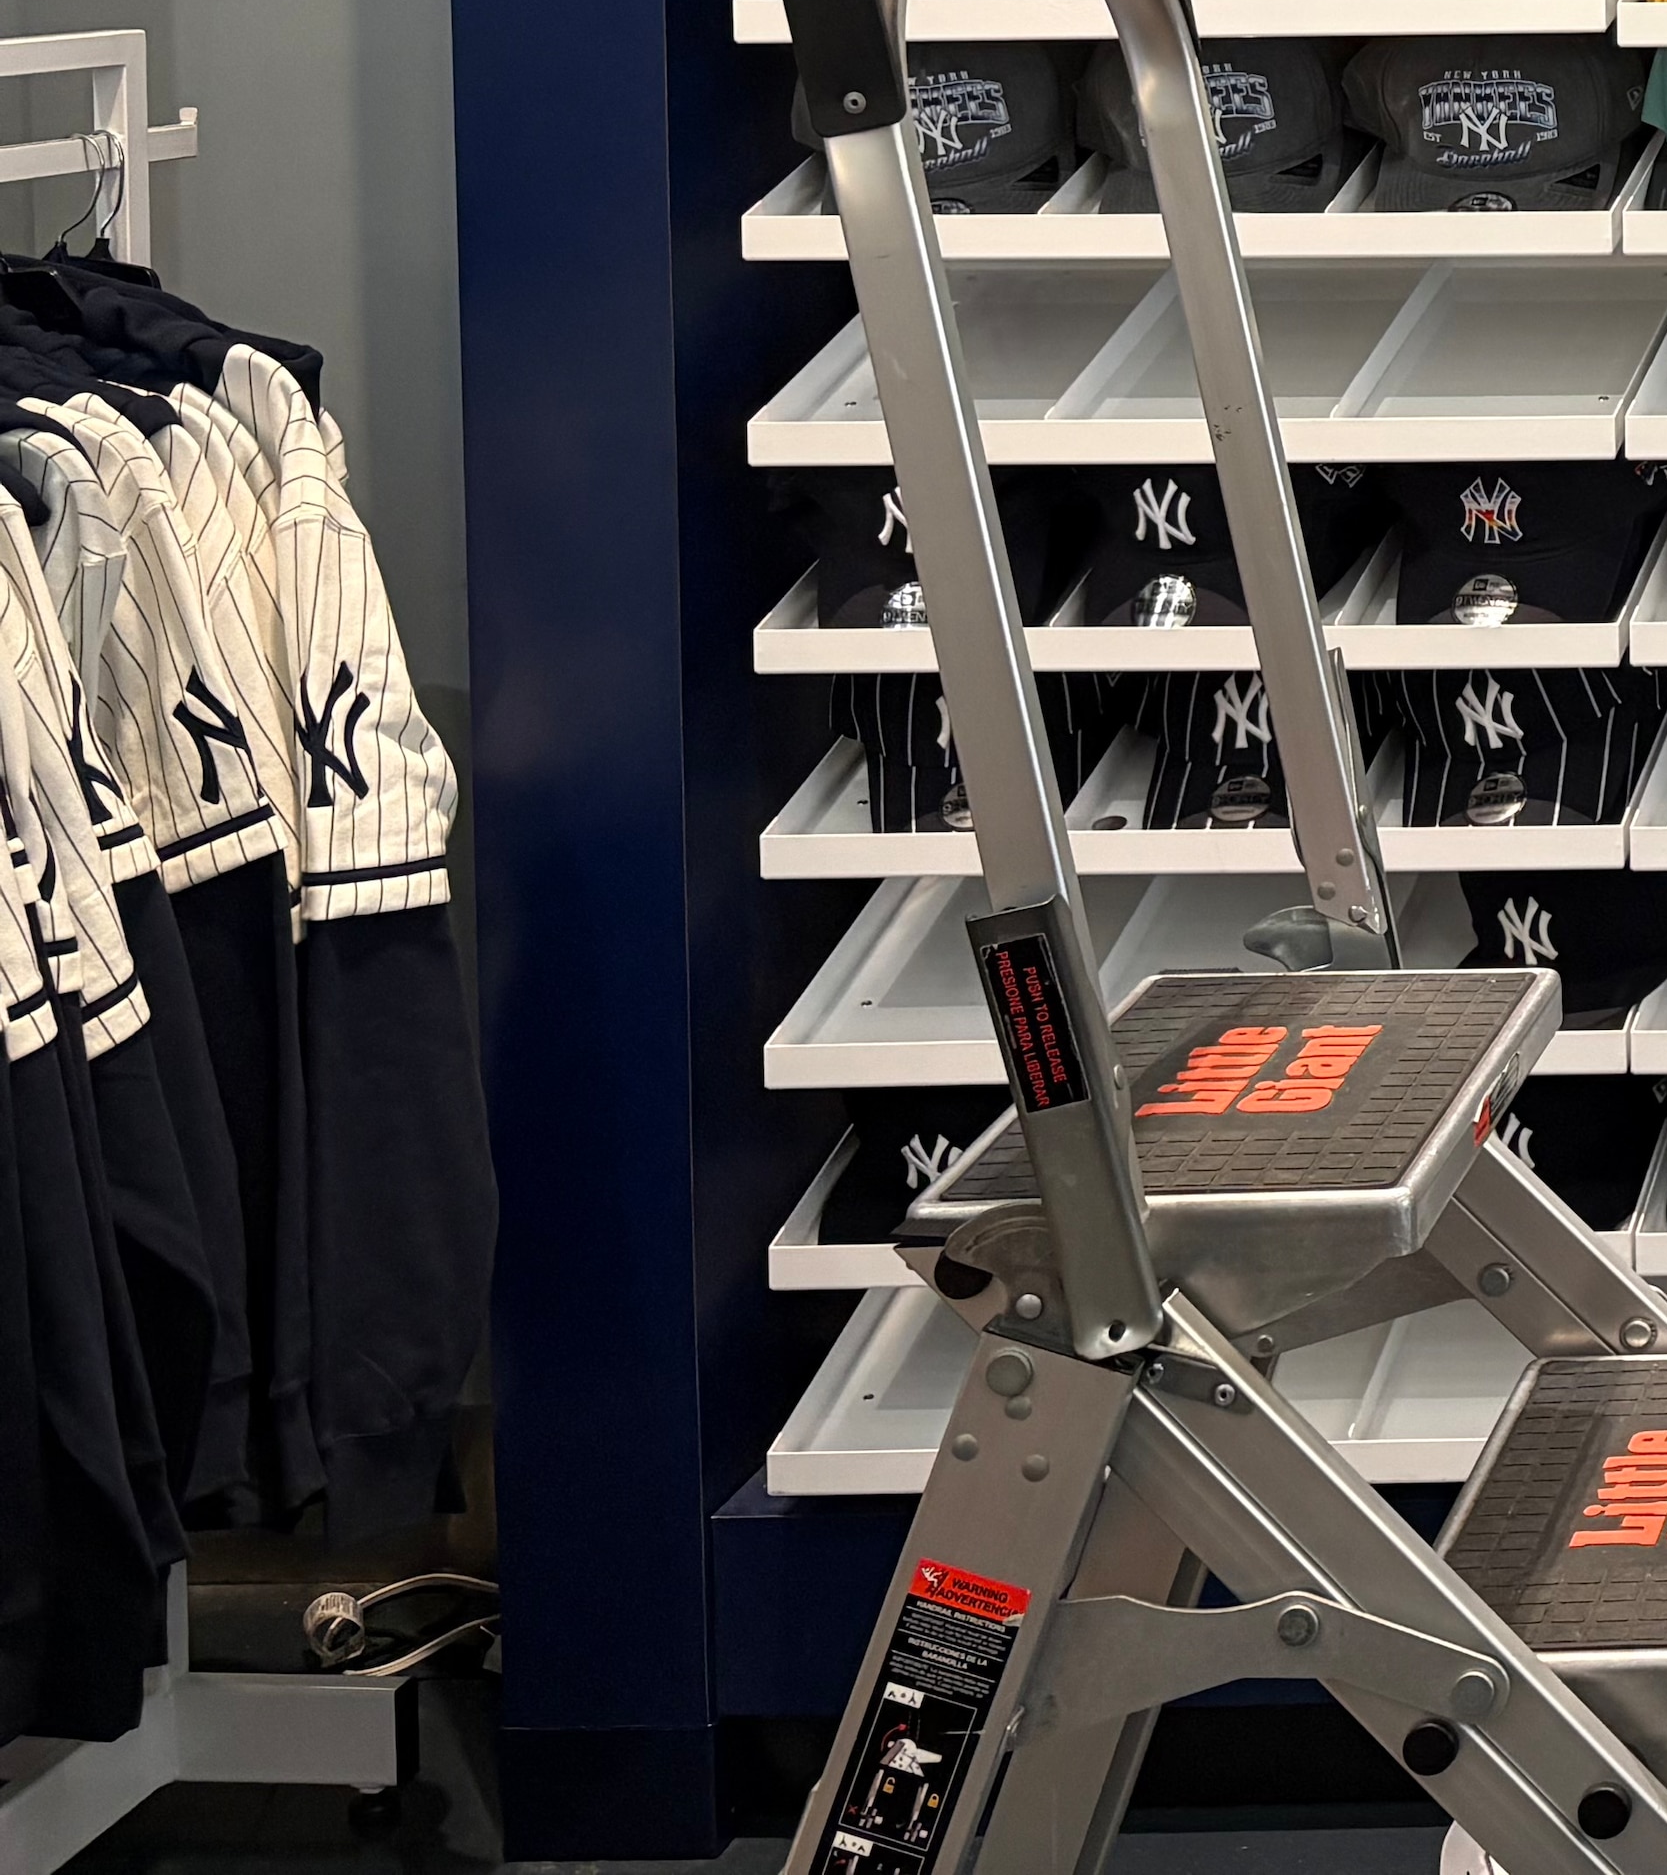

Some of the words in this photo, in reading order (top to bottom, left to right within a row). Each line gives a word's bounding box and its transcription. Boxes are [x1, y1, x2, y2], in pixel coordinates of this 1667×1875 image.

[1444, 70, 1472, 79] NEW
[1481, 69, 1521, 79] YORK
[1418, 80, 1557, 130] YANKEES
[1459, 106, 1508, 151] NY
[1132, 476, 1197, 549] NY
[1211, 674, 1272, 749] NY
[1497, 896, 1559, 966] NY
[1022, 966, 1045, 1003] PUSH
[1034, 1004, 1049, 1022] TO
[995, 951, 1025, 1014] PRESIONE
[1013, 1017, 1034, 1051] PARA
[1024, 1052, 1051, 1108] LIBERAR
[1039, 1023, 1068, 1083] RELEASE
[1136, 1026, 1288, 1116] Little
[1237, 1024, 1383, 1113] Giant
[951, 1578, 1008, 1604] WARNING
